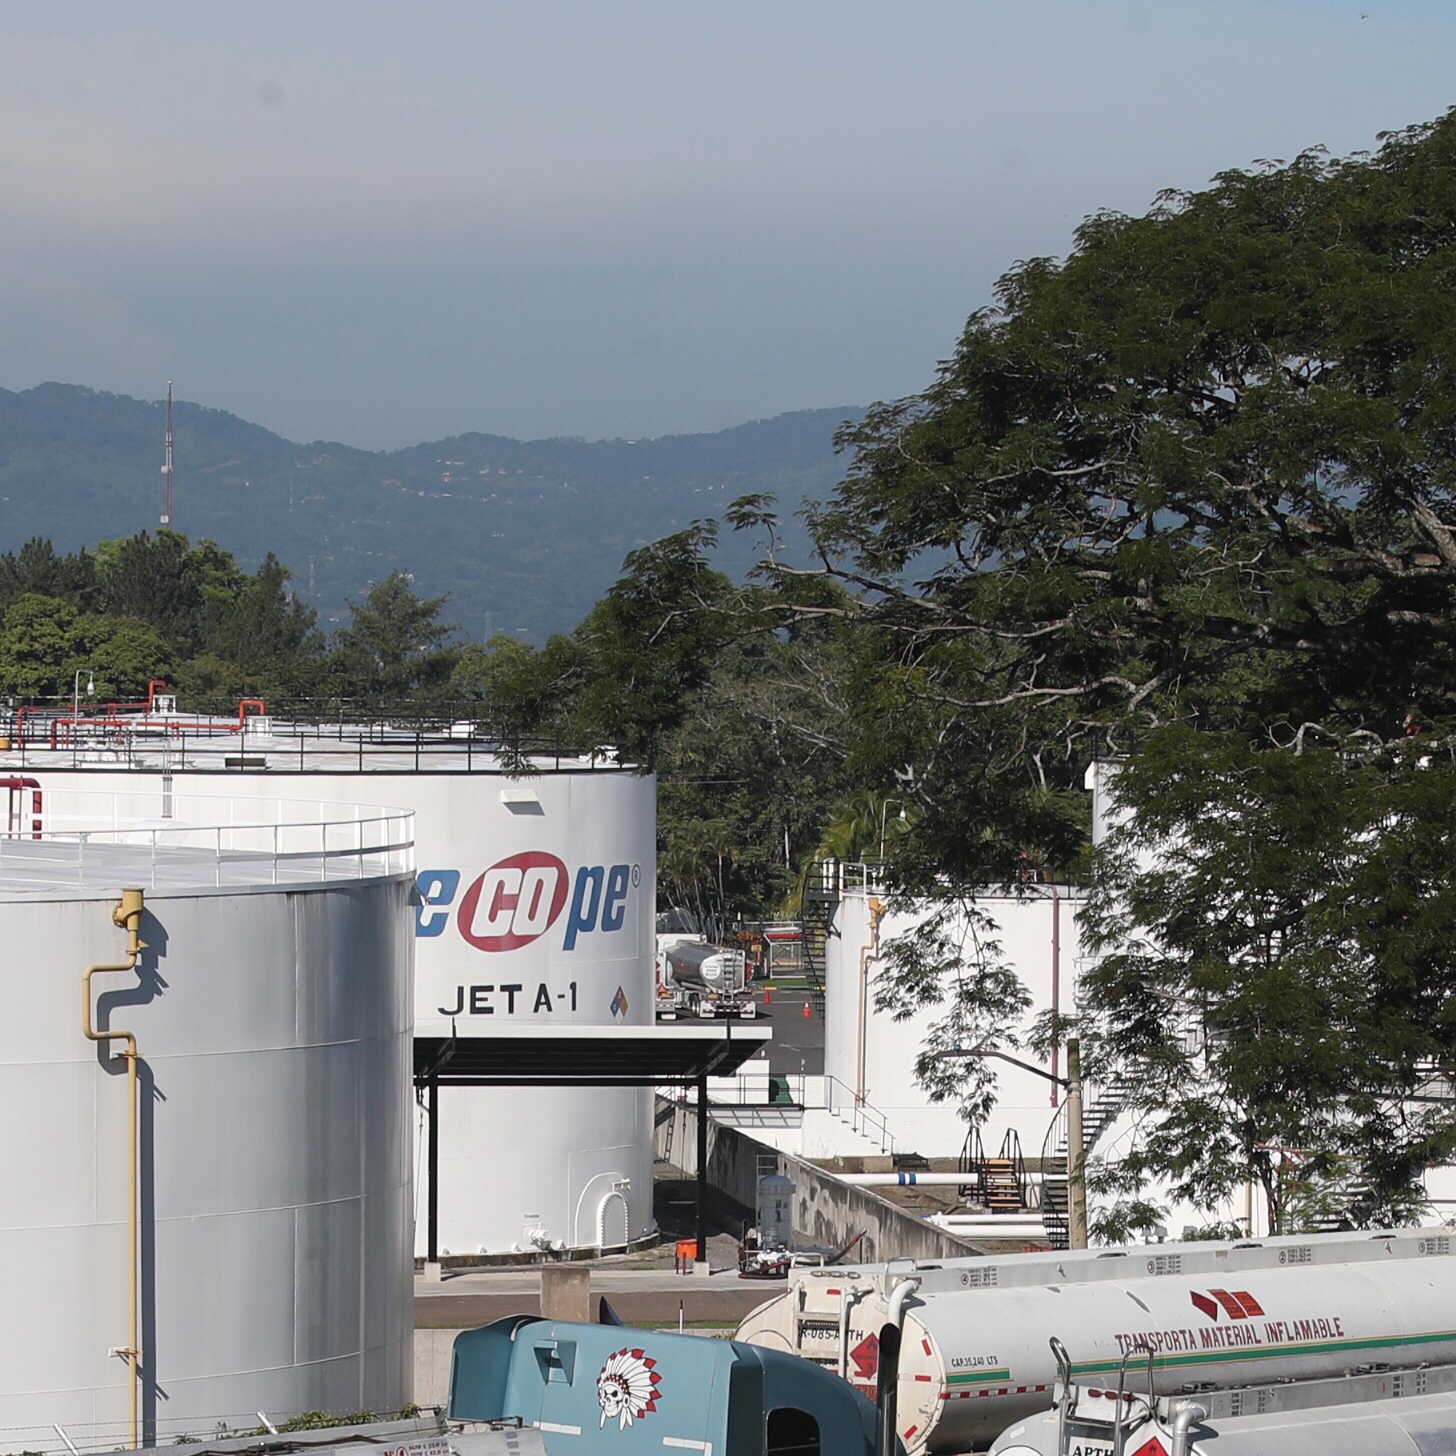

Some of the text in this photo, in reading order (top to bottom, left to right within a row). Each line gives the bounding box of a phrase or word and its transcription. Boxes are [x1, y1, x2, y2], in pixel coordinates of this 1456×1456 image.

[416, 864, 631, 951] ecope
[437, 981, 578, 1016] JET A-1
[1114, 1317, 1345, 1355] TRANSPORTA MATERIAL INFLAMABLE
[987, 1355, 999, 1366] LTS
